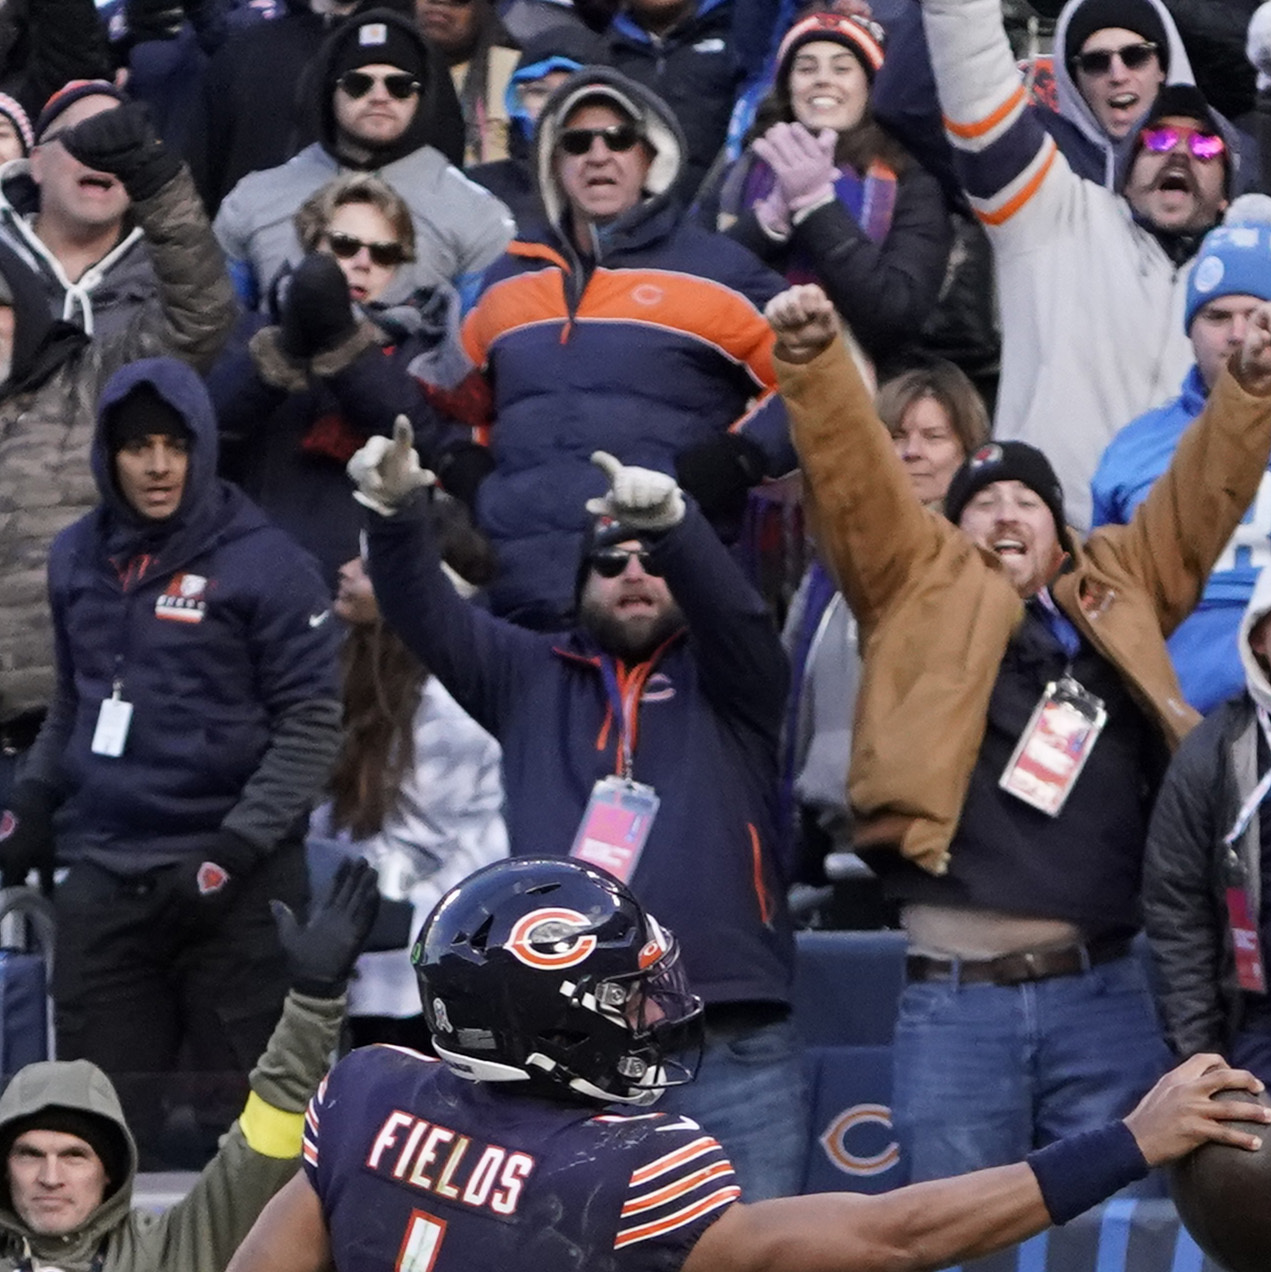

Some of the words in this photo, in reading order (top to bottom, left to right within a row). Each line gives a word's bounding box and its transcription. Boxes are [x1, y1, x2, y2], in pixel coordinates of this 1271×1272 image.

[503, 907, 598, 970] C
[366, 1109, 536, 1215] FIELDS
[818, 1103, 900, 1177] C
